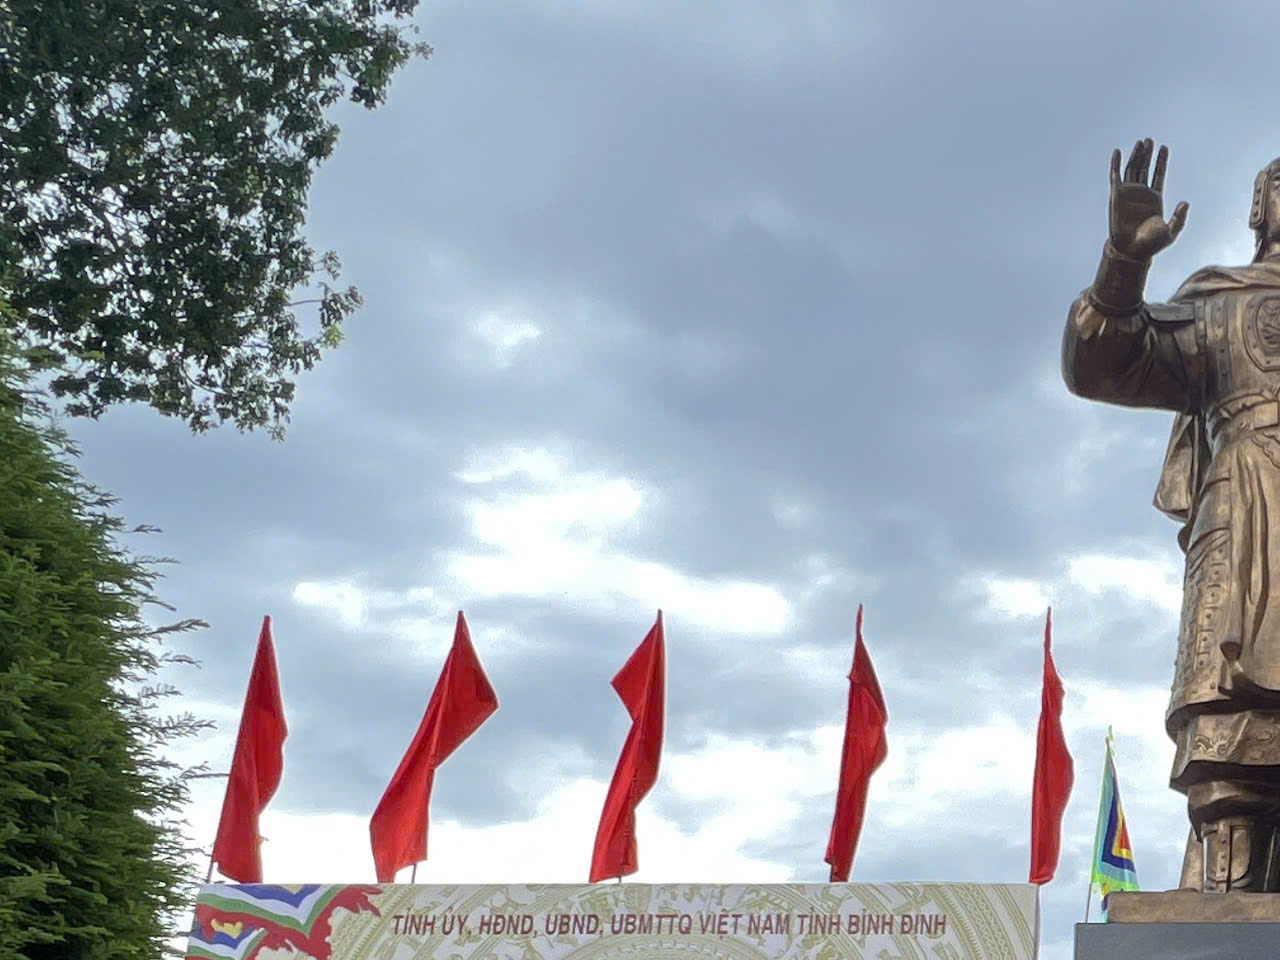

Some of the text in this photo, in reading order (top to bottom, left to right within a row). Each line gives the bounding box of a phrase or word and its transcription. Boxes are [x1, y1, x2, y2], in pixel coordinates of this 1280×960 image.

[393, 907, 436, 935] TỈNH
[441, 906, 471, 938] ỦY,
[479, 914, 537, 938] HĐND,
[610, 914, 692, 937] UBMTTQ
[700, 909, 743, 940] VIỆT
[747, 914, 790, 935] NAM
[798, 907, 841, 935] TỈNH
[848, 909, 894, 935] BÌNH
[900, 914, 946, 939] ĐỊNH
